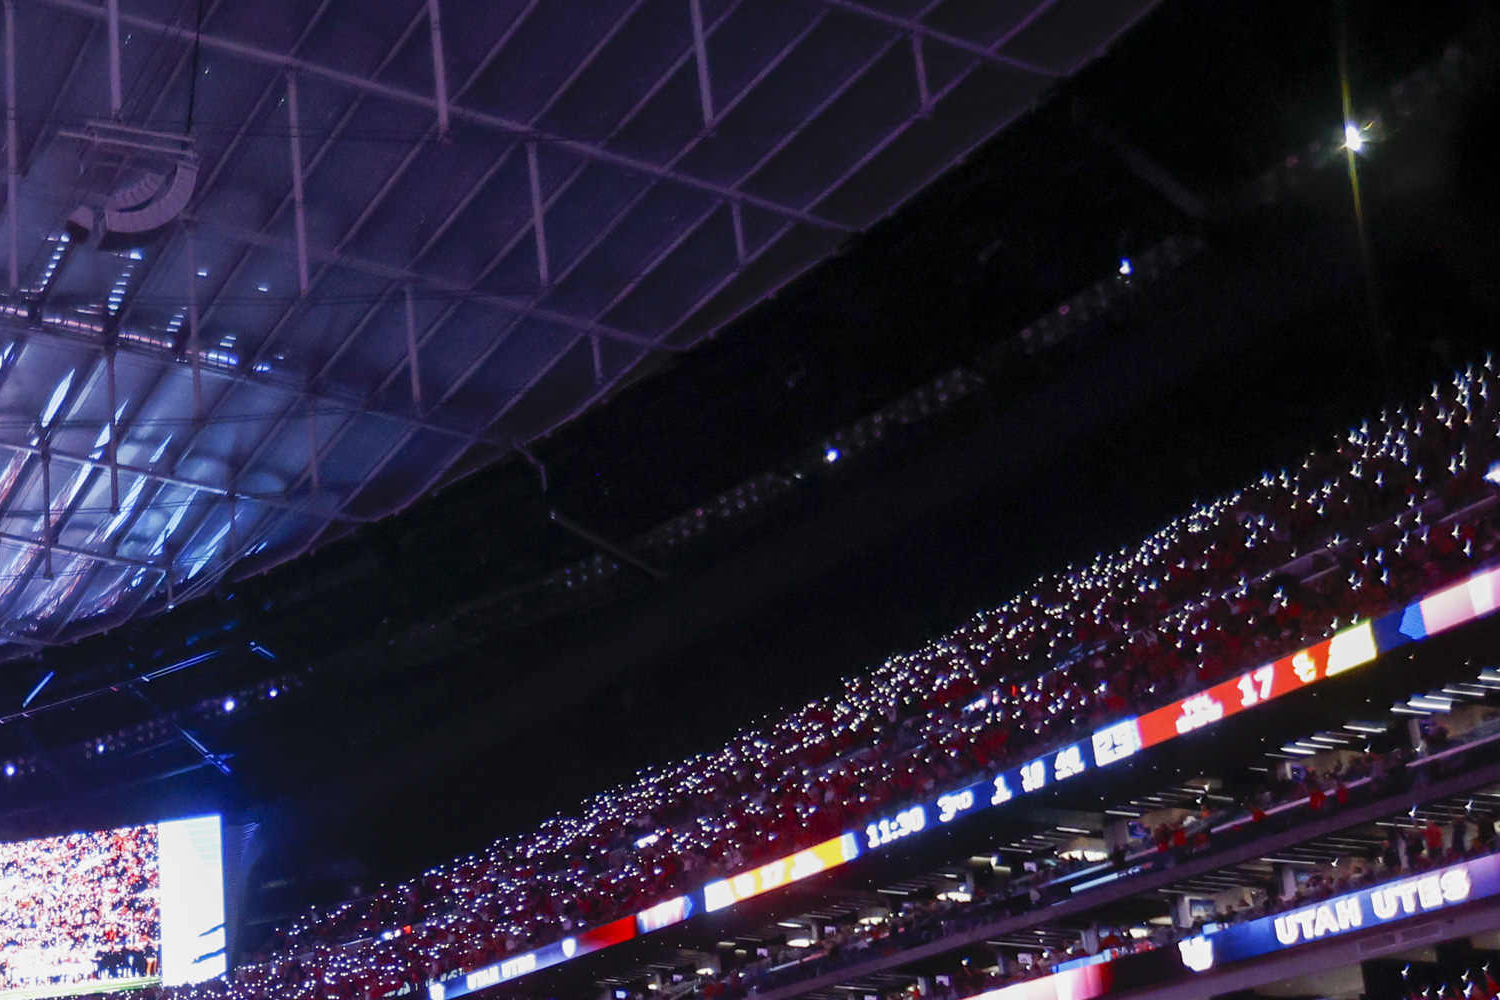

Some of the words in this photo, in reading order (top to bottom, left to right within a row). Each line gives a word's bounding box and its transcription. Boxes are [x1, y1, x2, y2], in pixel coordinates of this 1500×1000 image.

[1237, 664, 1274, 706] 17
[1274, 896, 1363, 945] UTAH
[1371, 867, 1471, 919] UTES
